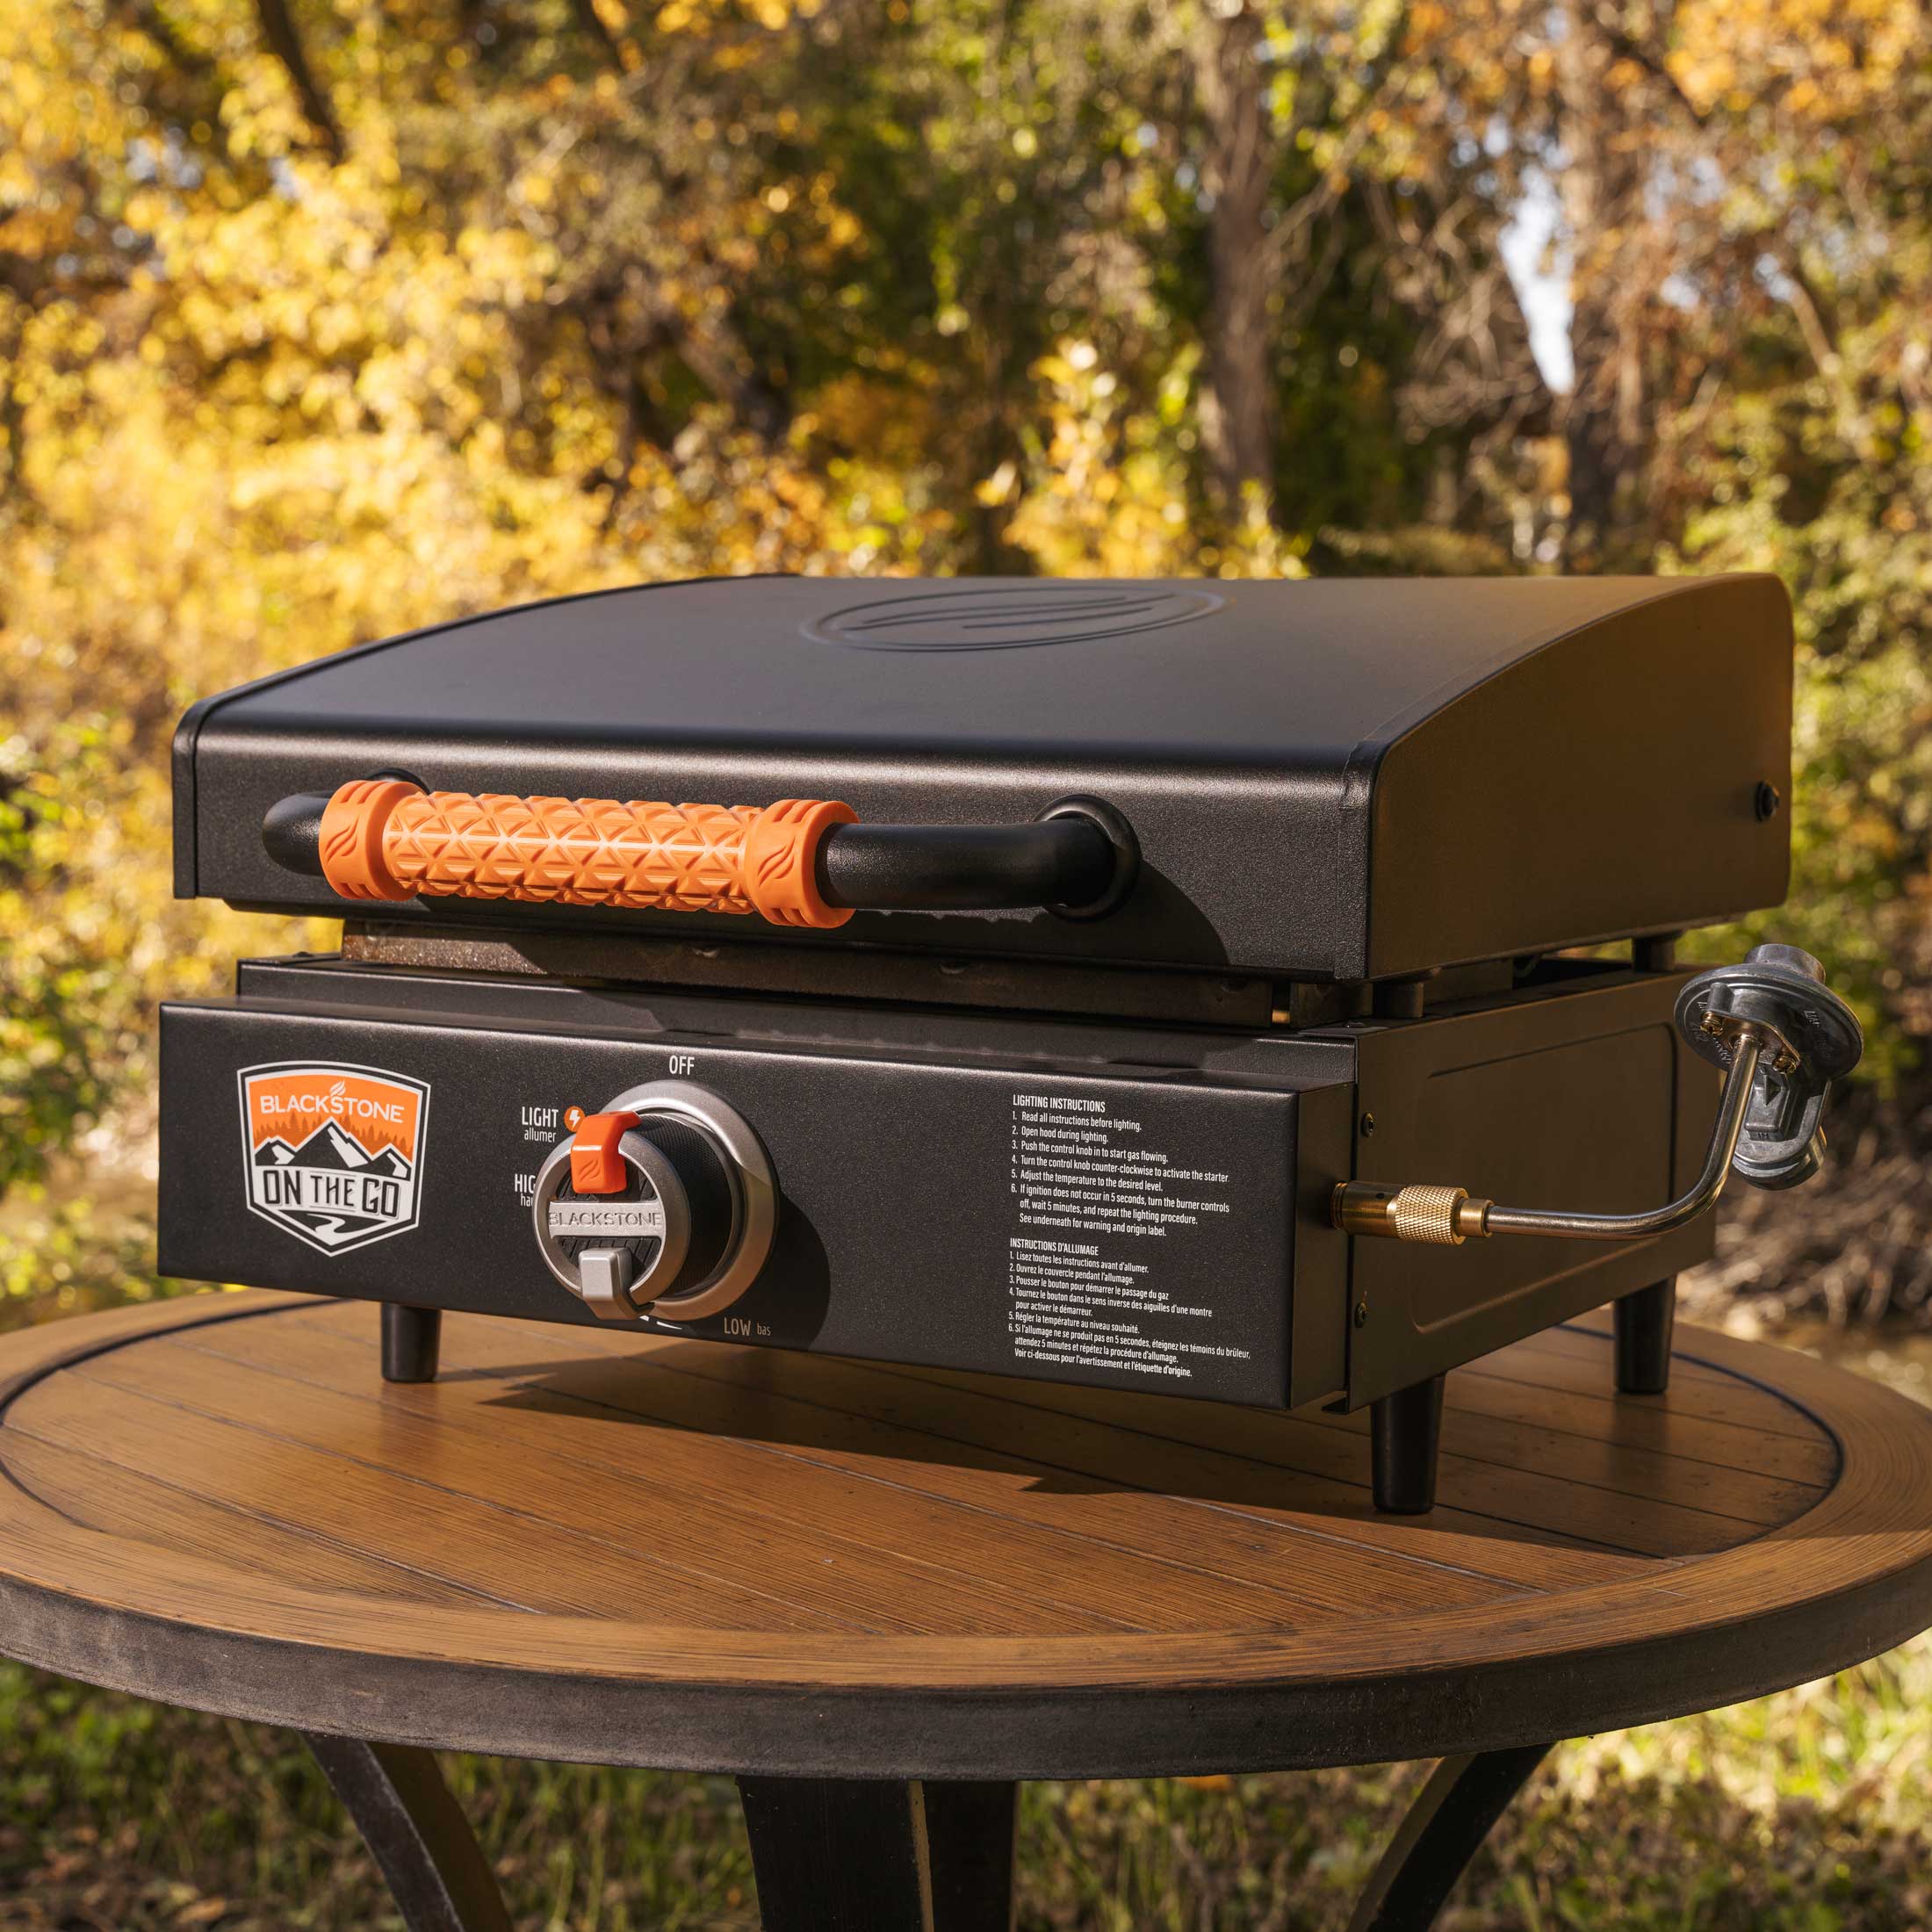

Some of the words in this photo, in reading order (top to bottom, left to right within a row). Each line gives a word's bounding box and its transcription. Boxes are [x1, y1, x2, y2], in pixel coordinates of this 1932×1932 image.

[669, 1056, 695, 1075] OFF
[260, 1094, 405, 1123] BLACKSTONE
[1013, 1094, 1049, 1108] LIGHTING
[1049, 1097, 1106, 1113] INSTRUCTIONS
[522, 1107, 559, 1128] LIGHT
[1013, 1110, 1017, 1121] 1.
[1021, 1111, 1038, 1122] Read
[1039, 1112, 1048, 1122] all
[1049, 1113, 1090, 1127] instructions
[1091, 1116, 1113, 1128] before
[1114, 1118, 1142, 1133] lighting.
[524, 1128, 556, 1143] allumer
[1012, 1125, 1018, 1135] 2.
[1021, 1126, 1038, 1138] Open
[1040, 1127, 1056, 1138] hood
[1057, 1128, 1079, 1143] during
[1081, 1130, 1108, 1145] lighting.
[1012, 1139, 1018, 1150] 3.
[1021, 1140, 1037, 1151] Push
[1038, 1142, 1049, 1152] the
[1050, 1144, 1075, 1154] control
[1076, 1144, 1092, 1156] knob
[1093, 1146, 1100, 1157] in
[1101, 1148, 1108, 1157] to
[1110, 1149, 1127, 1159] start
[1128, 1151, 1140, 1162] gas
[1141, 1150, 1168, 1164] flowing.
[1012, 1154, 1018, 1164] 4.
[1020, 1155, 1035, 1165] Turn
[1036, 1156, 1048, 1166] the
[1049, 1158, 1072, 1169] control
[1074, 1159, 1091, 1171] knob
[1092, 1163, 1153, 1176] counter-clockwise
[1154, 1167, 1162, 1177] to
[1163, 1168, 1191, 1179] activate
[1191, 1170, 1203, 1180] the
[515, 1173, 536, 1194] HIG
[1012, 1168, 1018, 1179] 5.
[1020, 1169, 1042, 1182] Adjust
[1042, 1171, 1054, 1182] the
[1055, 1172, 1097, 1186] temperature
[1098, 1177, 1105, 1186] to
[1106, 1177, 1117, 1187] the
[1118, 1178, 1143, 1190] desired
[1145, 1180, 1163, 1192] level.
[263, 1170, 302, 1206] ON
[310, 1175, 356, 1207] THE
[362, 1178, 400, 1218] GO
[1011, 1183, 1017, 1193] 6.
[1020, 1183, 1026, 1193] If
[1027, 1184, 1052, 1197] ignition
[1053, 1186, 1070, 1198] does
[1071, 1189, 1082, 1199] not
[1083, 1192, 1102, 1200] occur
[1103, 1191, 1110, 1201] in
[1111, 1193, 1115, 1202] 5
[1116, 1194, 1147, 1206] seconds,
[1148, 1196, 1163, 1207] turn
[1164, 1197, 1175, 1208] the
[1176, 1198, 1200, 1210] burner
[1200, 1202, 1229, 1213] controls
[549, 1212, 663, 1226] BLACKSTONE
[1020, 1198, 1030, 1209] off,
[1032, 1200, 1047, 1210] wait
[1047, 1200, 1052, 1211] 5
[1053, 1201, 1082, 1215] minutes,
[1083, 1205, 1096, 1215] and
[1098, 1208, 1120, 1218] repeat
[1121, 1208, 1132, 1219] the
[1133, 1208, 1159, 1223] lighting
[1160, 1213, 1198, 1225] procedure.
[1020, 1212, 1032, 1223] See
[1033, 1215, 1071, 1228] underneath
[1072, 1217, 1082, 1229] for
[1083, 1220, 1111, 1234] warning
[1112, 1222, 1126, 1233] and
[1127, 1223, 1147, 1236] origin
[1148, 1224, 1166, 1236] label.
[1010, 1237, 1056, 1251] INSTRUCTIONS
[1010, 1251, 1014, 1259] 1.
[1016, 1251, 1032, 1262] Lisez
[1033, 1253, 1052, 1264] toutes
[1053, 1255, 1062, 1265] les
[1063, 1256, 1099, 1268] instructions
[1100, 1261, 1118, 1271] avant
[1009, 1263, 1015, 1272] 2.
[1016, 1263, 1037, 1274] Ouvrez
[1038, 1265, 1043, 1275] le
[1044, 1268, 1074, 1278] couvercle
[1075, 1270, 1100, 1281] pendant
[1009, 1274, 1015, 1284] 3.
[1016, 1275, 1041, 1287] Pousser
[1041, 1278, 1047, 1287] le
[1048, 1279, 1069, 1289] bouton
[1071, 1283, 1085, 1292] pour
[1115, 1286, 1121, 1295] le
[1121, 1288, 1148, 1300] passage
[1149, 1289, 1157, 1299] du
[1157, 1292, 1169, 1301] gaz
[1009, 1287, 1014, 1296] 4.
[1015, 1287, 1039, 1299] Tournez
[1040, 1289, 1046, 1299] le
[1047, 1290, 1068, 1301] bouton
[1069, 1293, 1084, 1303] dans
[1085, 1294, 1091, 1304] le
[1092, 1297, 1107, 1306] sens
[1107, 1297, 1130, 1308] inverse
[1131, 1300, 1143, 1309] des
[1143, 1301, 1170, 1313] aiguilles
[1189, 1308, 1212, 1317] montre
[1015, 1301, 1030, 1310] pour
[1030, 1301, 1052, 1312] activer
[1053, 1303, 1058, 1313] le
[724, 1317, 752, 1337] LOW
[757, 1323, 771, 1336] bas
[1008, 1311, 1014, 1320] 5.
[1035, 1314, 1042, 1323] la
[1081, 1320, 1089, 1329] au
[1090, 1320, 1110, 1330] niveau
[1008, 1323, 1014, 1332] 6.
[1015, 1323, 1020, 1333] Si
[1071, 1330, 1092, 1341] produit
[1093, 1334, 1105, 1344] pas
[1114, 1335, 1119, 1344] 5
[1120, 1337, 1150, 1348] secondes,
[1179, 1342, 1189, 1352] les
[1216, 1346, 1224, 1356] du
[1014, 1337, 1041, 1347] attendez
[1042, 1338, 1046, 1348] 5
[1047, 1339, 1071, 1351] minutes
[1072, 1343, 1078, 1352] et
[1103, 1345, 1109, 1355] la
[1014, 1348, 1027, 1358] Voir
[1027, 1349, 1060, 1362] ci-dessous
[1061, 1354, 1075, 1364] pour
[1123, 1361, 1130, 1370] et
